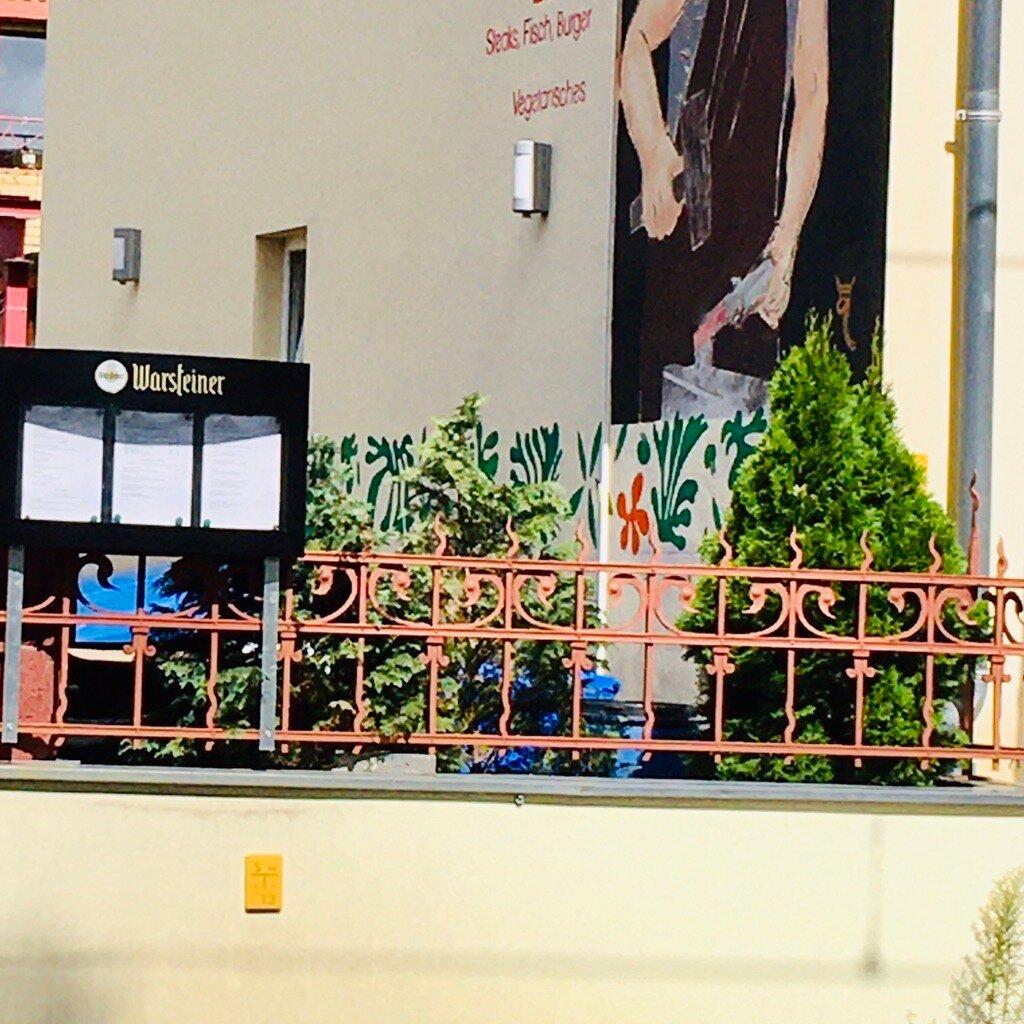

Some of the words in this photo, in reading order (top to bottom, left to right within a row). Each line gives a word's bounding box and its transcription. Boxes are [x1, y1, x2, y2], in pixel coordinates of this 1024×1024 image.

[523, 15, 553, 44] Fisch
[557, 9, 592, 41] Burger
[132, 363, 226, 396] Warsteiner
